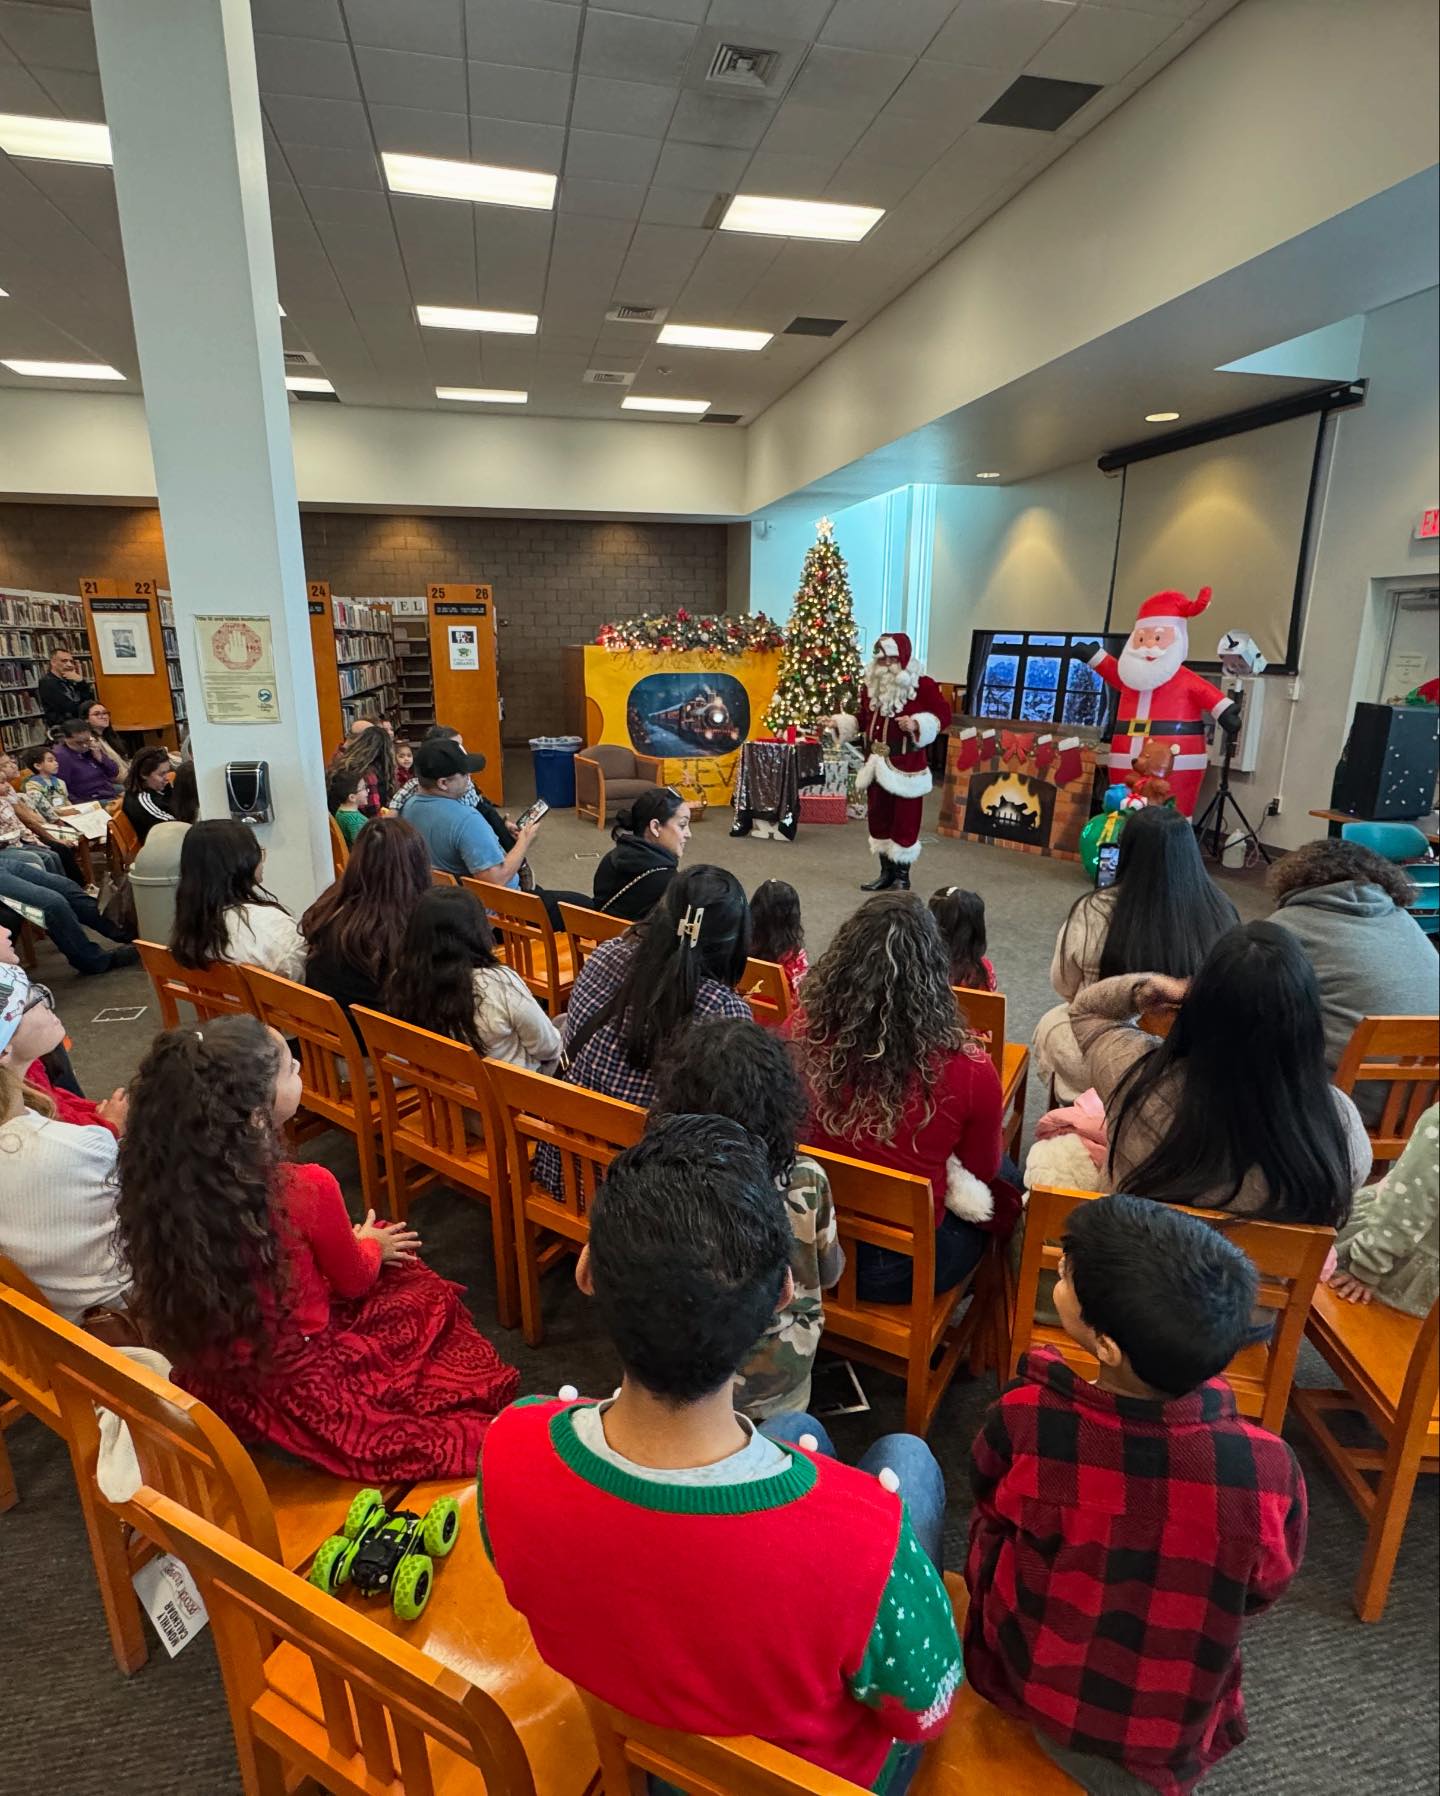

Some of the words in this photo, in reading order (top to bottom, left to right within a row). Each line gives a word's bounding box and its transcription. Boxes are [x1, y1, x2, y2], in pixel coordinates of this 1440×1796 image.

[84, 582, 98, 594] 21
[135, 582, 152, 594] 22
[311, 585, 326, 597] 24
[431, 588, 446, 599] 25
[163, 1600, 189, 1640] CALENDAR
[156, 1611, 180, 1648] MONTHLY
